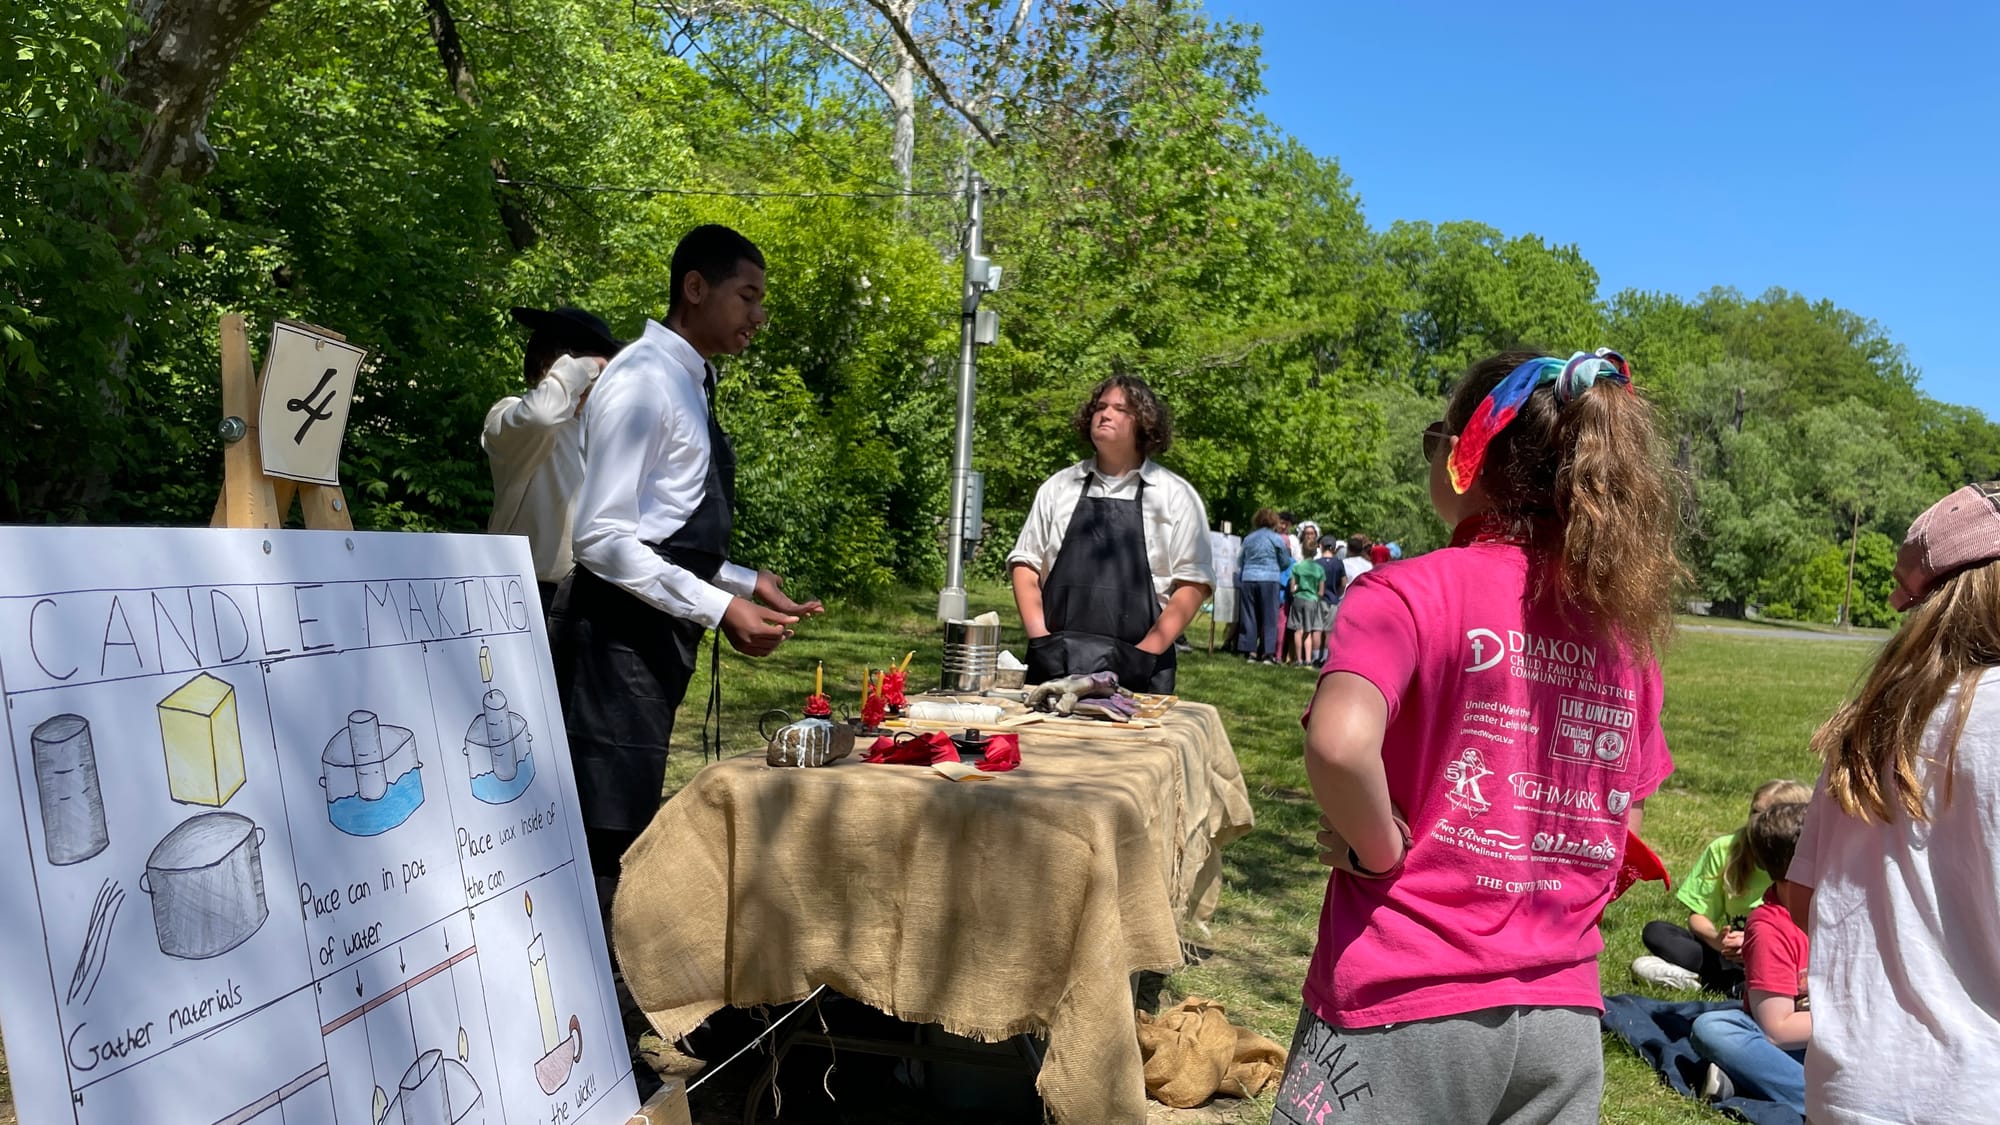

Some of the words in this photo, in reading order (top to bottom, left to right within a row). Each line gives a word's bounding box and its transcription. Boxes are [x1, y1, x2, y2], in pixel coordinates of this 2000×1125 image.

[287, 368, 337, 445] 4
[30, 584, 334, 680] CANDLE
[364, 578, 529, 648] MAKING
[1507, 630, 1597, 668] DIAKON
[1510, 666, 1574, 688] COMMUNITY
[1463, 713, 1498, 726] Greater
[1465, 701, 1497, 711] United
[1561, 699, 1584, 718] LIVE
[1585, 705, 1633, 728] UNITED
[1561, 723, 1593, 739] United
[1573, 739, 1590, 757] Way
[457, 827, 493, 859] Place
[499, 825, 515, 846] wax
[521, 811, 543, 835] inside
[546, 803, 556, 825] of
[1431, 831, 1455, 846] Health
[1466, 842, 1502, 859] Wellness
[1435, 818, 1455, 834] Two
[1457, 826, 1496, 847] Rivers
[300, 882, 341, 920] Place
[348, 881, 371, 905] can
[382, 867, 395, 891] in
[403, 859, 426, 893] pot
[466, 876, 486, 900] the
[487, 870, 505, 892] can
[1476, 875, 1503, 889] THE
[319, 936, 335, 965] of
[68, 1022, 154, 1071] Gather
[74, 1092, 84, 1106] 4
